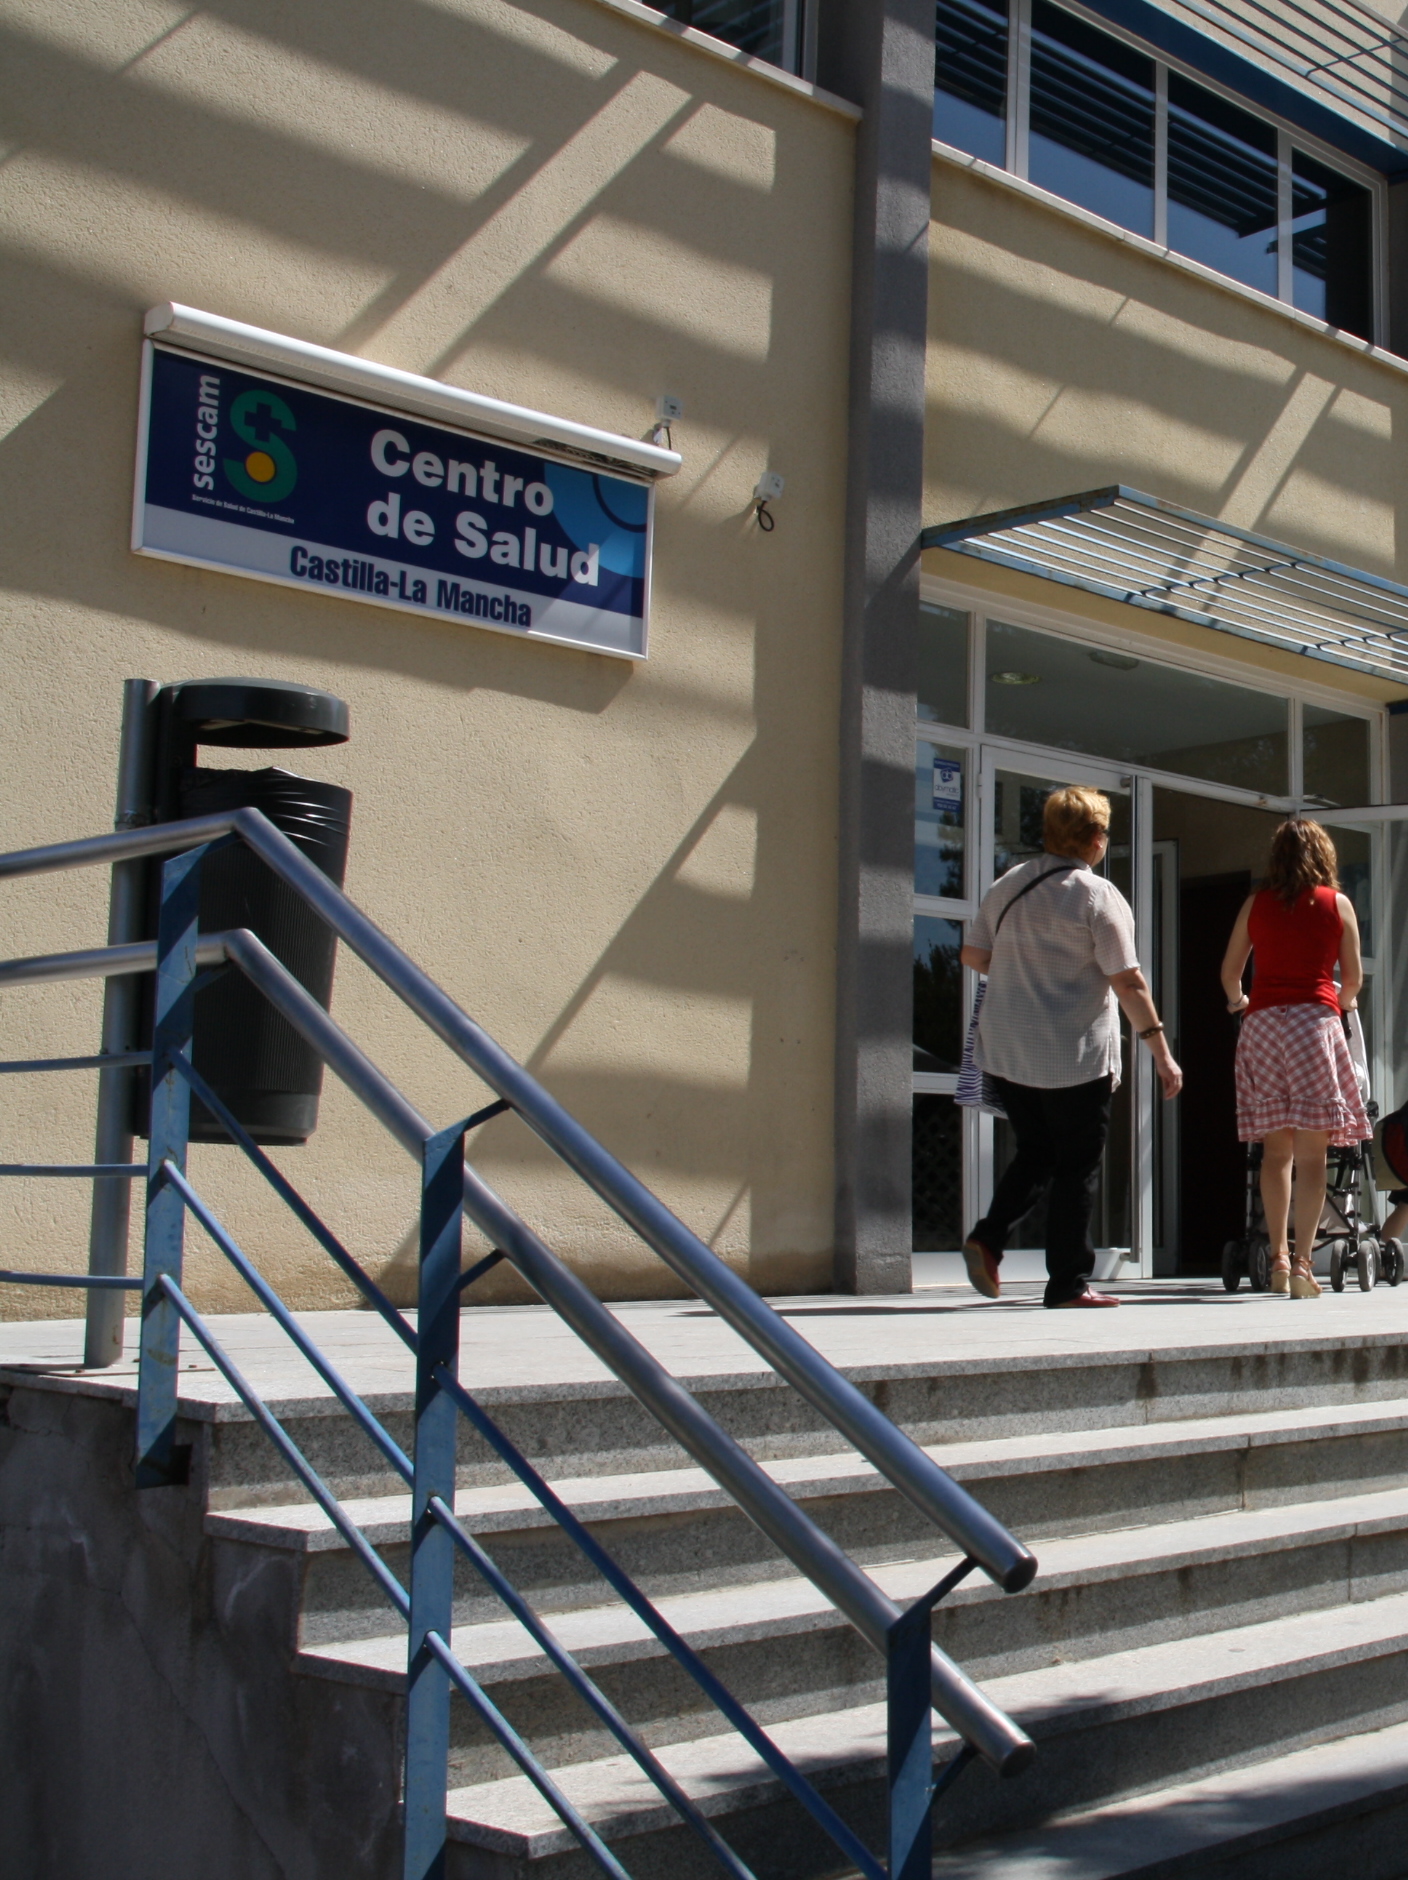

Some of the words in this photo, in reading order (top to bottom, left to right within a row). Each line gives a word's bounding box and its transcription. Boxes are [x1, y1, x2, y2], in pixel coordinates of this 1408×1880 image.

[193, 375, 221, 491] sescam
[371, 429, 554, 516] Centro
[192, 494, 215, 505] Servicio
[215, 499, 223, 507] de
[223, 501, 238, 511] Salud
[239, 505, 246, 513] de
[274, 513, 295, 525] Mancha
[366, 492, 435, 546] de
[455, 511, 599, 587] Salud
[290, 546, 427, 605] Castilla-La
[436, 582, 532, 627] Mancha
